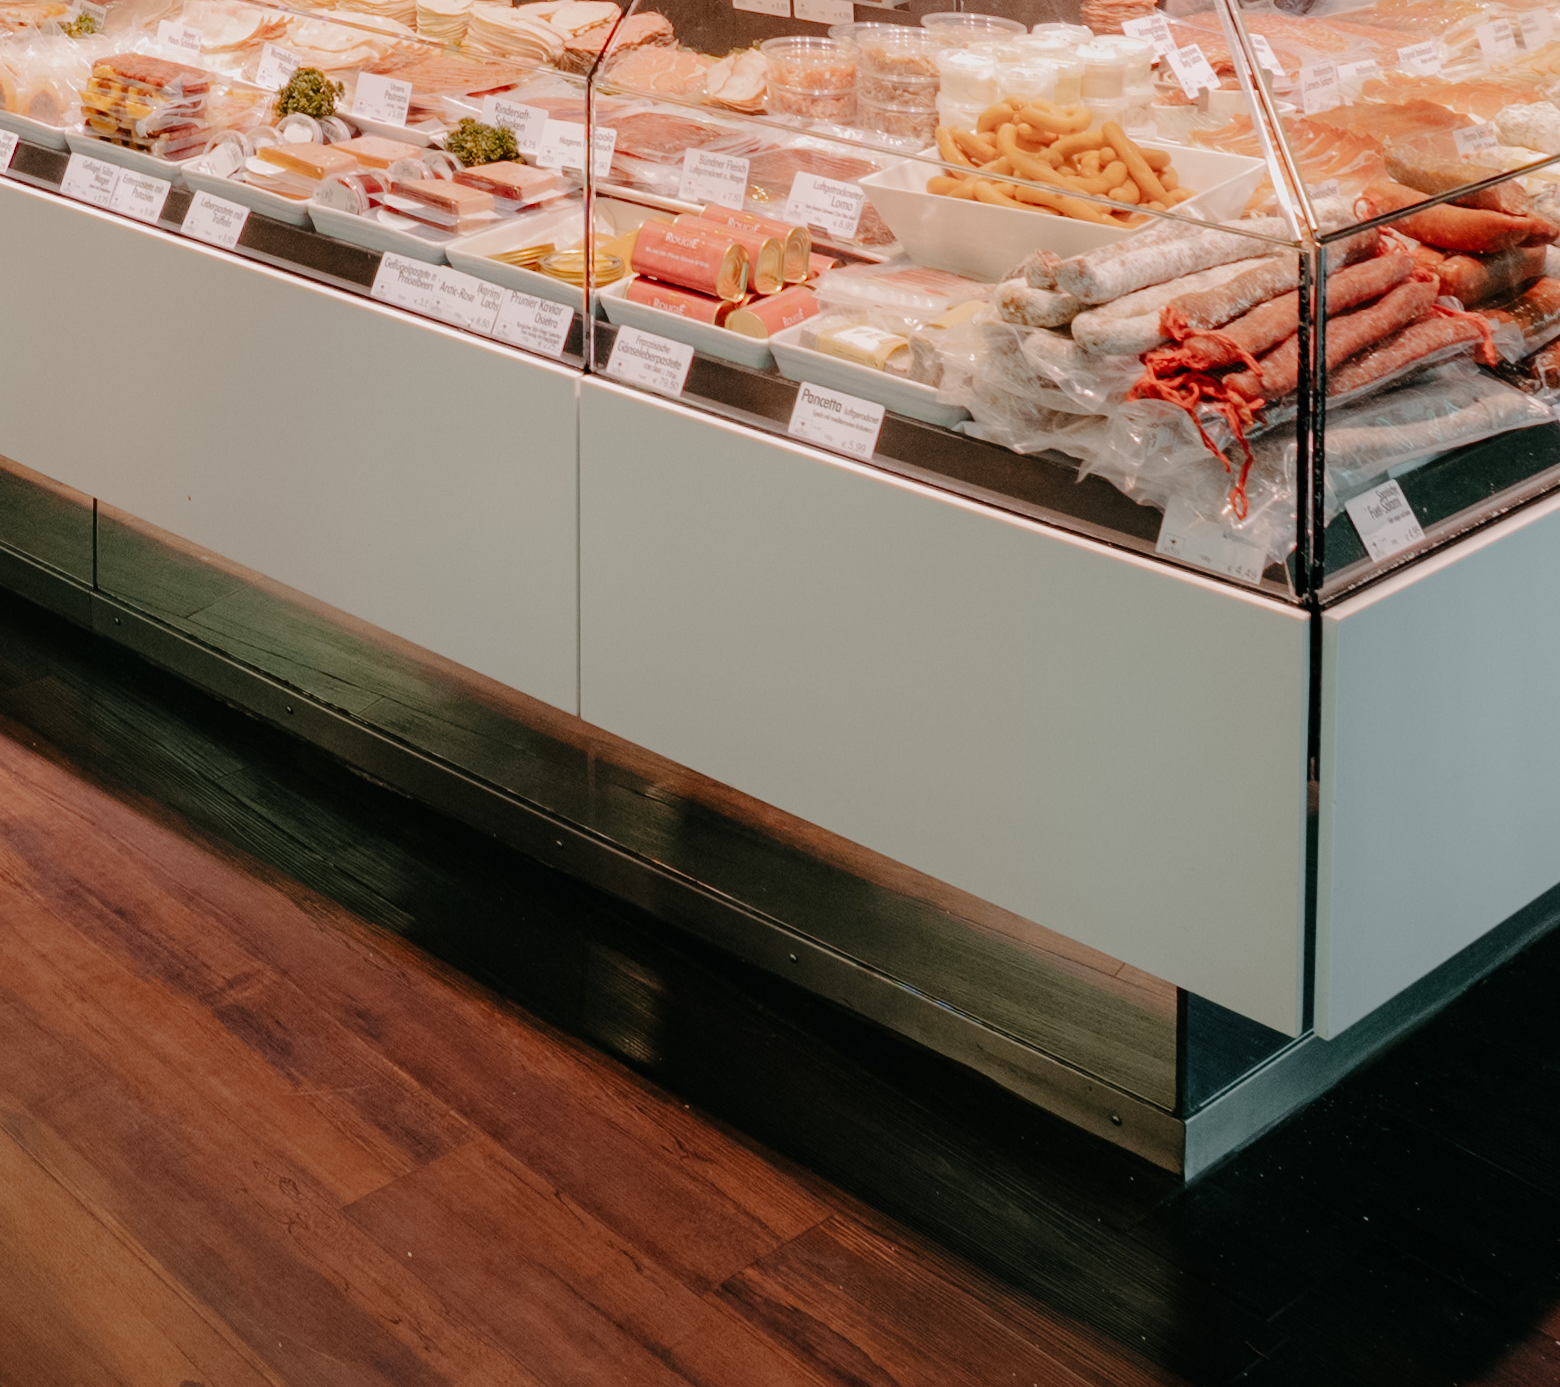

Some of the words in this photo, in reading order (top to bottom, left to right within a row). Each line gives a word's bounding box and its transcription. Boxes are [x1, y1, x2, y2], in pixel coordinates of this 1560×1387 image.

[494, 102, 532, 121] Rindersaft-
[698, 155, 726, 169] Bündner
[726, 160, 747, 173] Fleisch
[831, 196, 854, 211] Lomo
[480, 297, 500, 312] Lachs
[510, 292, 538, 309] Prunier
[539, 298, 564, 317] Kaviar
[635, 334, 671, 356] Französische
[617, 340, 682, 371] Gänseleberpastete
[801, 388, 843, 413] Pancetta
